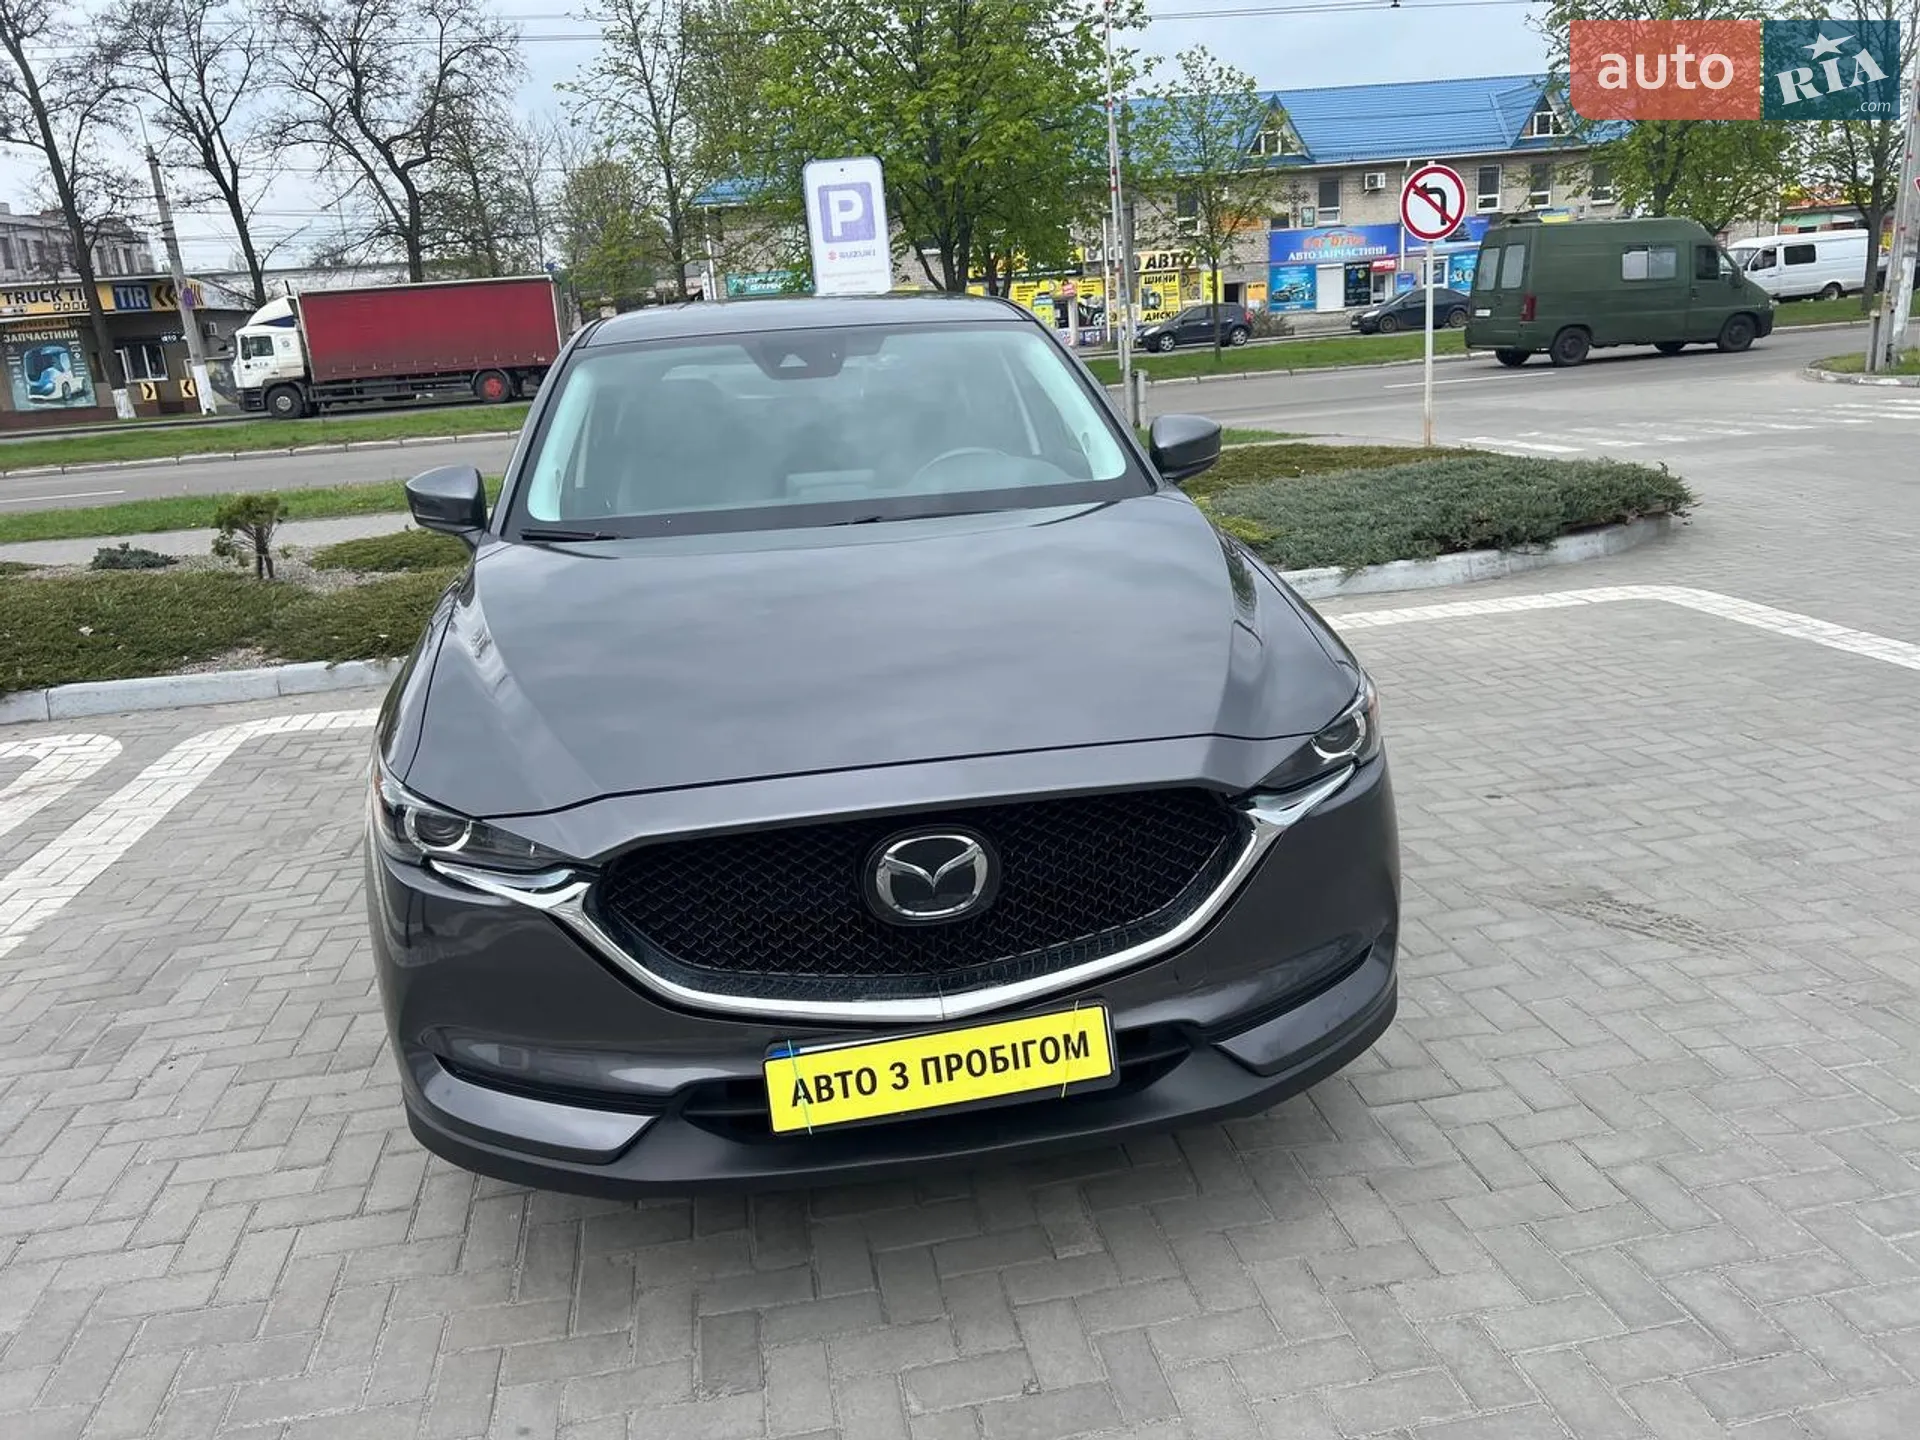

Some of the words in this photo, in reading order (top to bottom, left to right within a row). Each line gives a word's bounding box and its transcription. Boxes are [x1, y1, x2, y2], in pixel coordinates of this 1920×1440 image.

[828, 189, 863, 237] P
[1288, 245, 1388, 261] АВТОЗАПЧАСТИНИ
[1144, 274, 1176, 285] ШИНИ
[2, 287, 63, 305] TRUCK
[64, 287, 88, 302] TI
[114, 286, 149, 309] TIR
[3, 329, 79, 343] ЗАПЧАСТИНИ
[791, 1066, 878, 1107] АВТО
[888, 1061, 910, 1091] З
[920, 1030, 1091, 1087] ПРОБІГОМ
